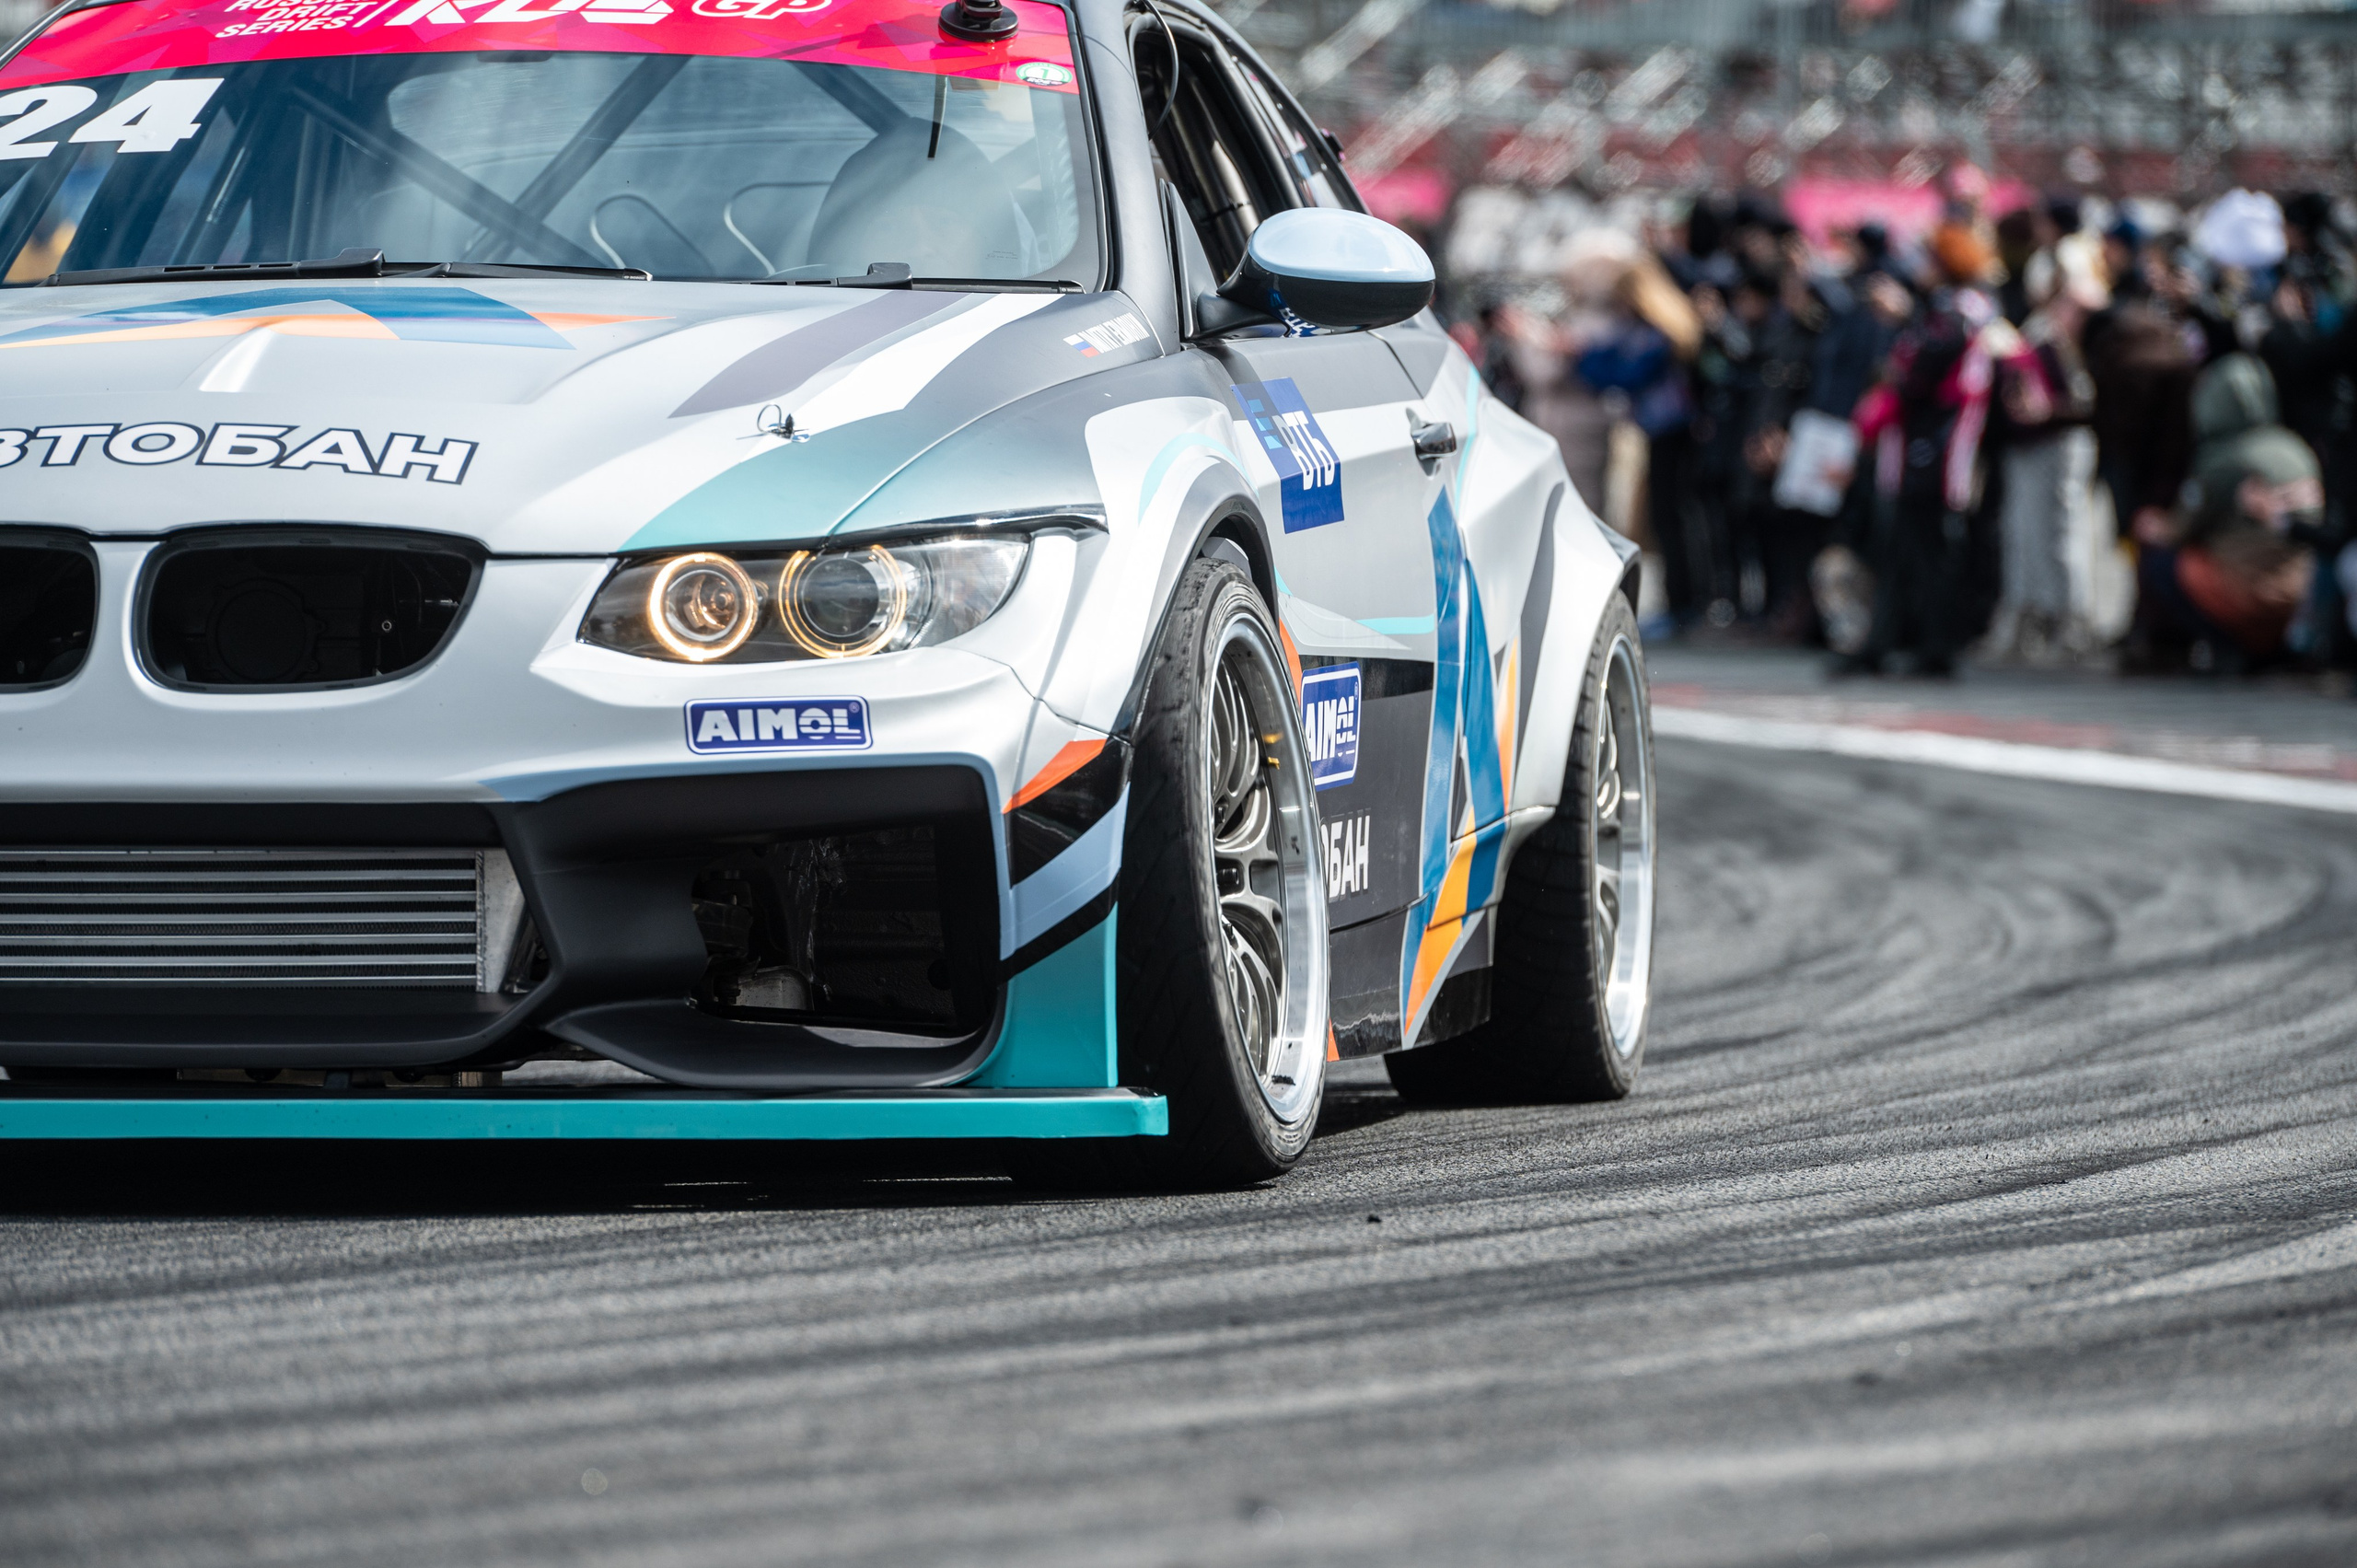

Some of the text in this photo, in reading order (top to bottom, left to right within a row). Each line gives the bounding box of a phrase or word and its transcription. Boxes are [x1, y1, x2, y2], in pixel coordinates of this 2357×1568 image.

[215, 16, 354, 38] SERIES
[256, 1, 377, 21] DRIFT
[0, 78, 225, 160] 24
[696, 707, 863, 742] AIMOL
[1305, 696, 1356, 762] AIMOL
